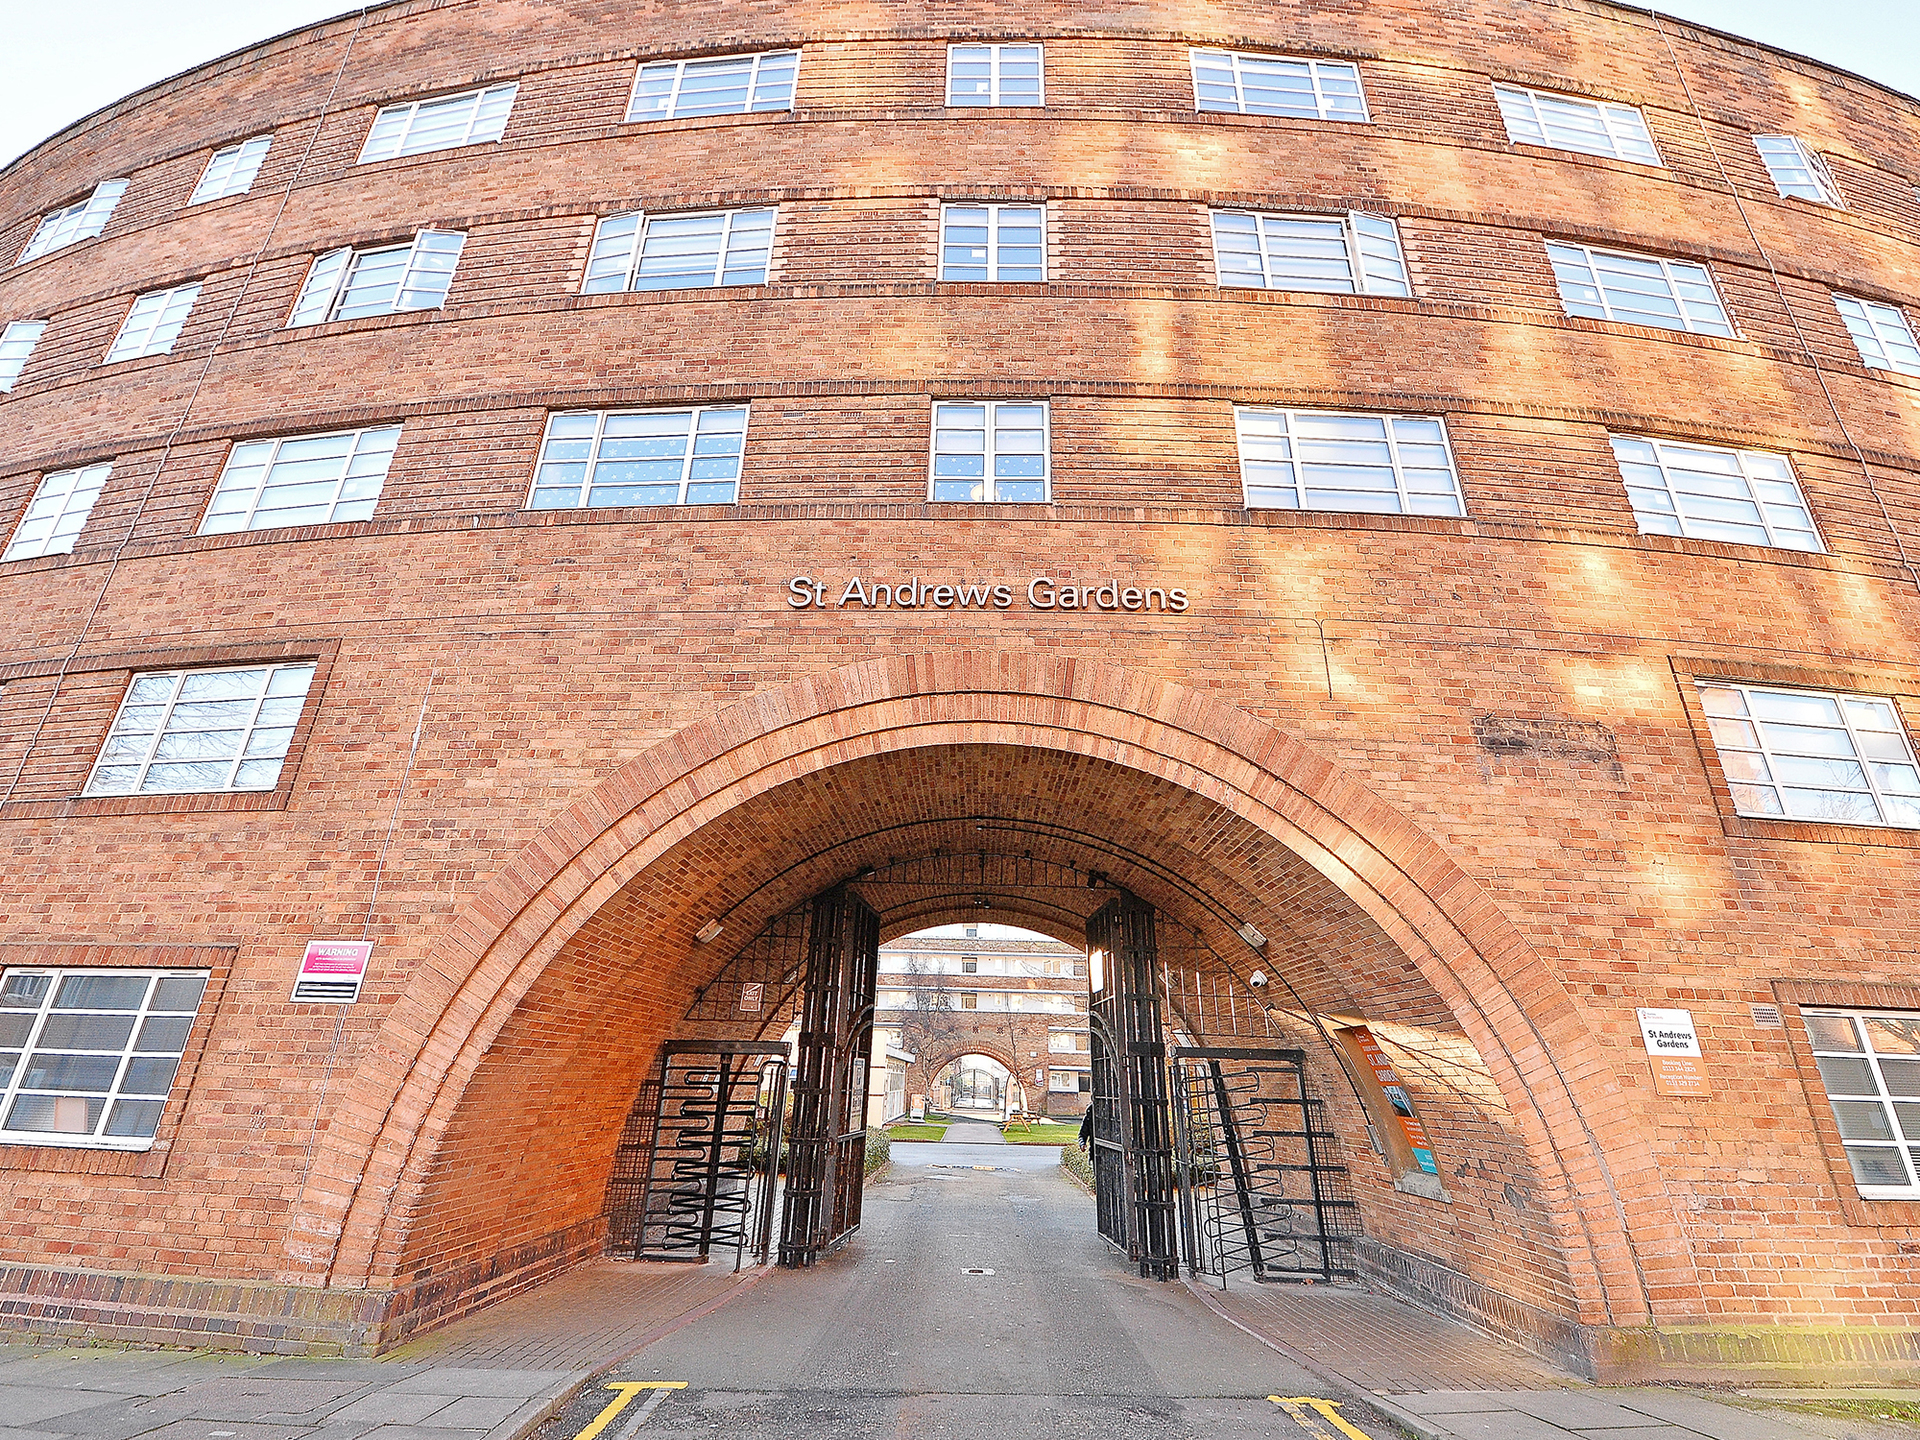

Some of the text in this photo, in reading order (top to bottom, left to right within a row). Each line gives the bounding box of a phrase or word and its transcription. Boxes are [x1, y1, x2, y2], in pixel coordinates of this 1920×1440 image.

[787, 576, 1190, 612] St Andrews Gardens
[318, 948, 359, 956] WARNING
[1648, 1030, 1692, 1040] St Andrews
[1656, 1040, 1689, 1048] Gardens
